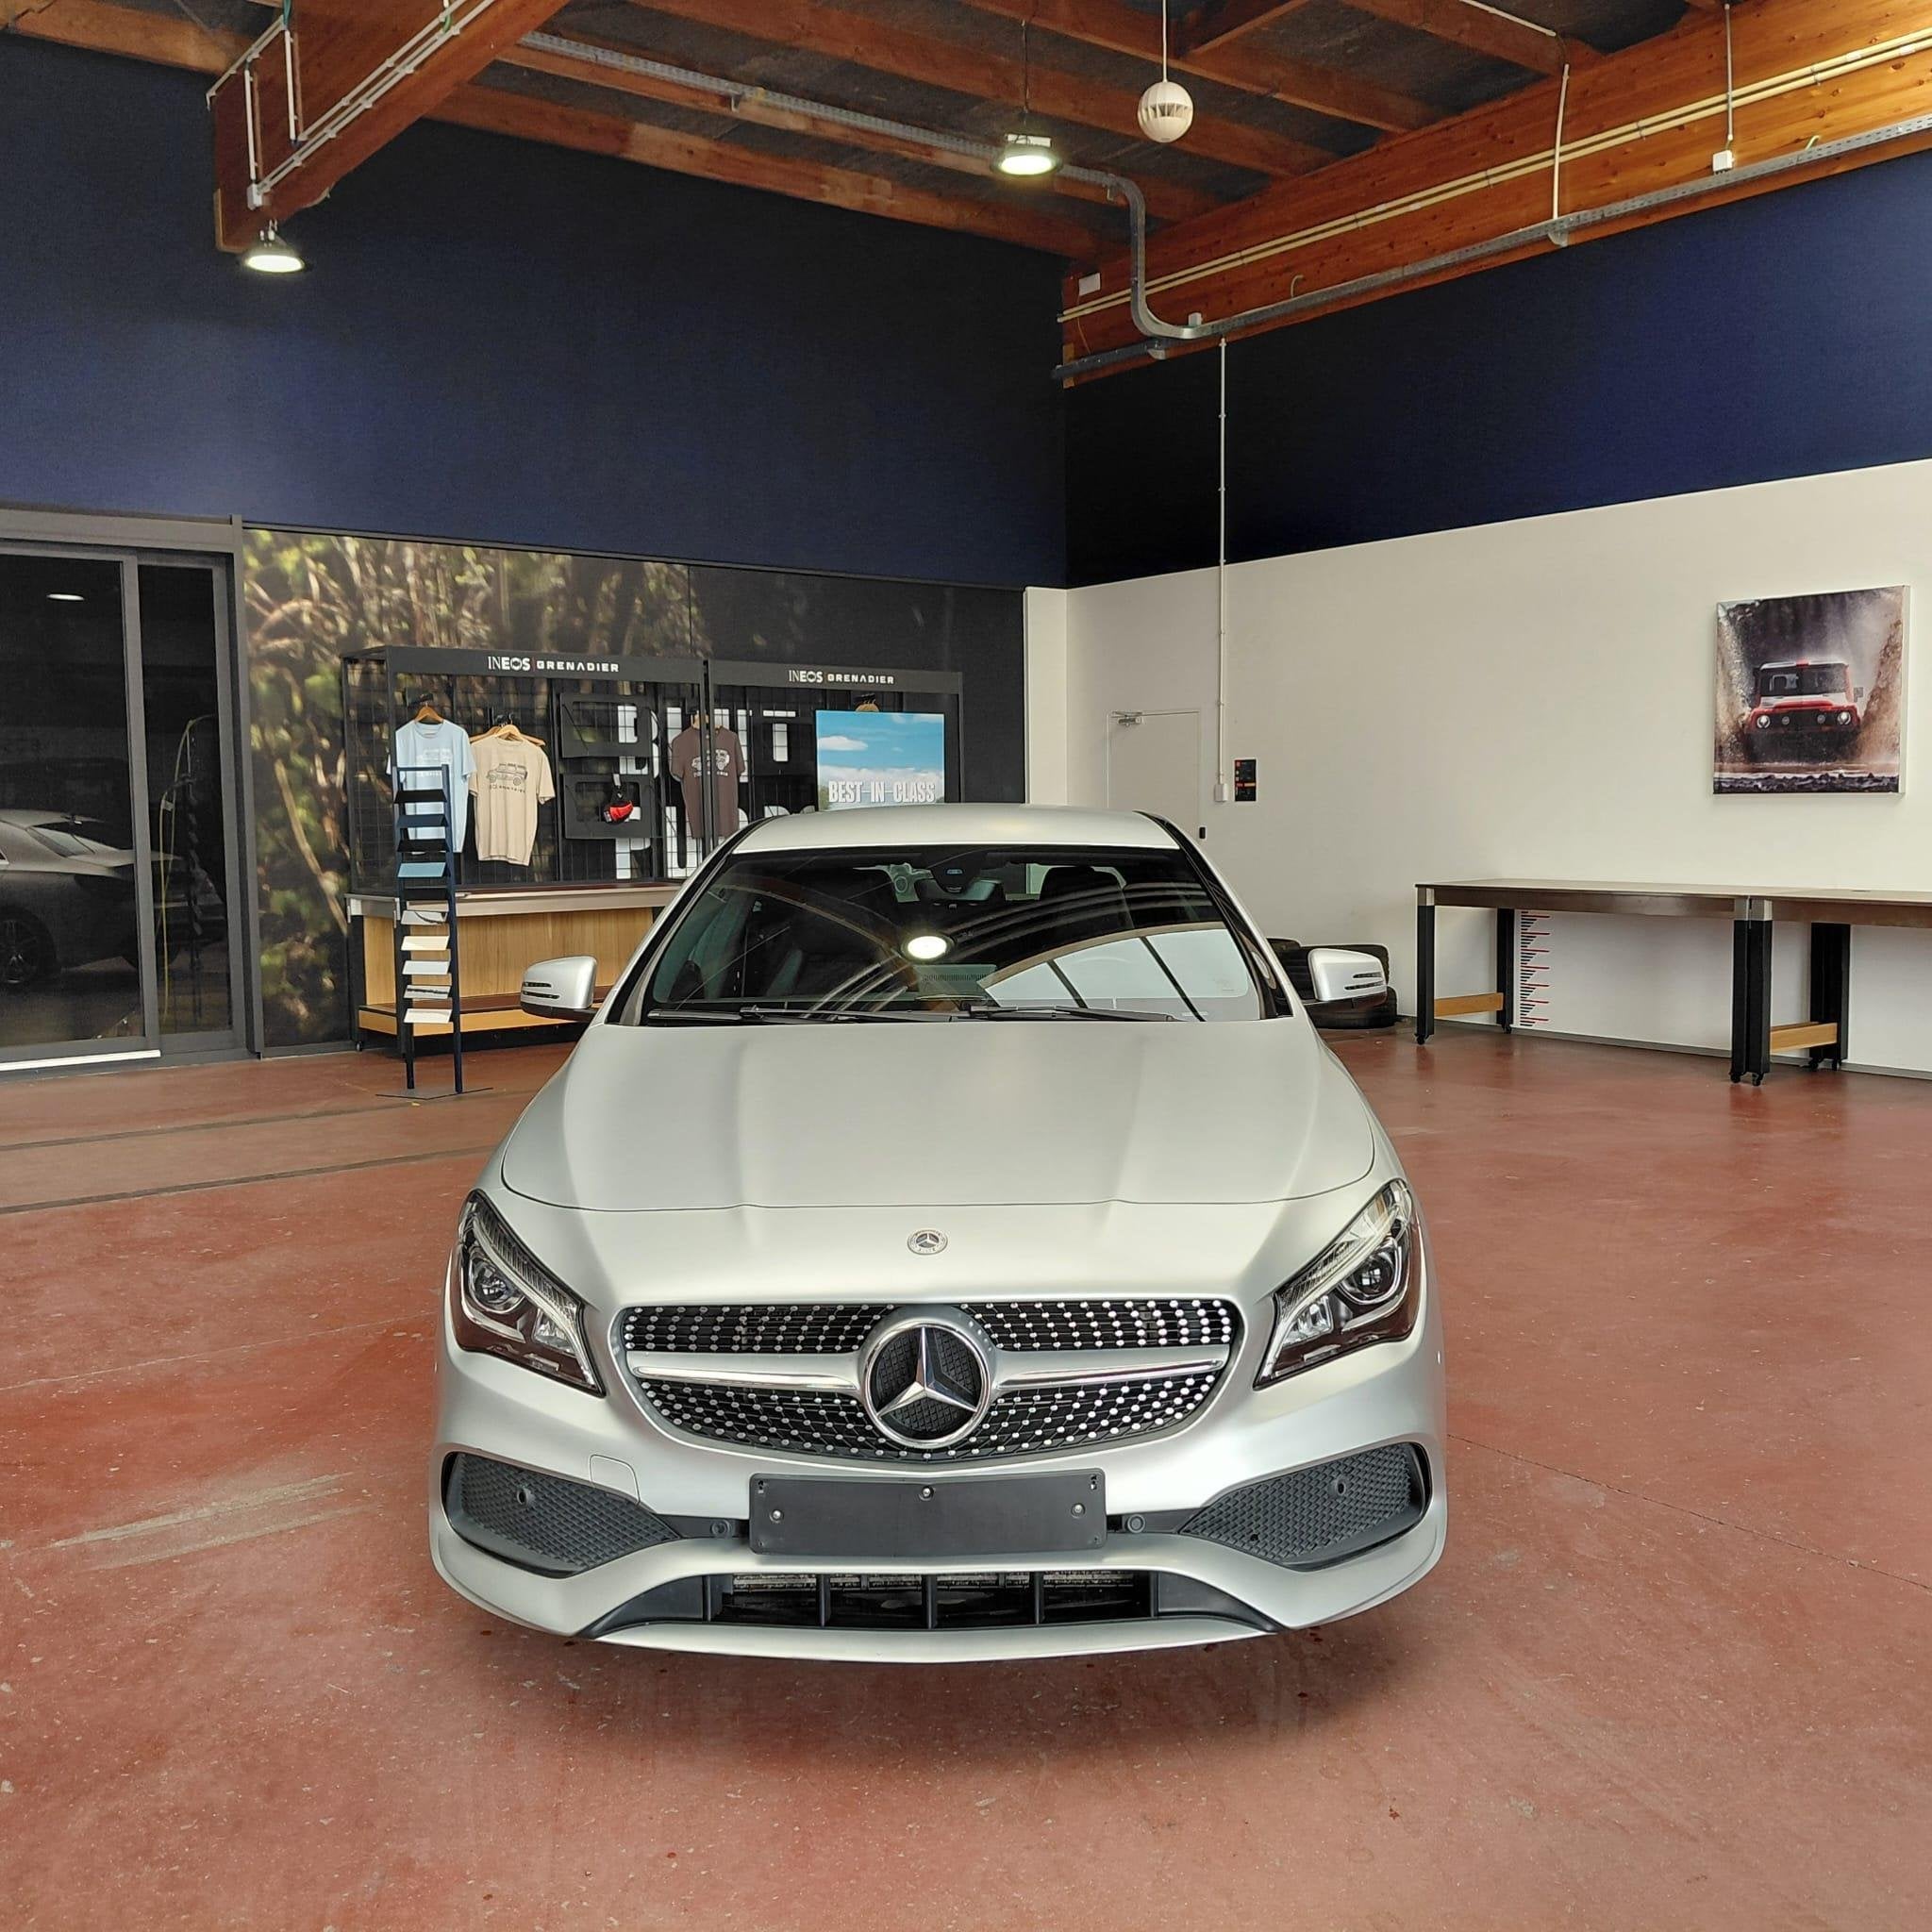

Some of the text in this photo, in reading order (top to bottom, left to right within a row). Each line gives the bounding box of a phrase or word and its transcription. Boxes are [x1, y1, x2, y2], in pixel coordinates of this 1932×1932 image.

[487, 656, 620, 673] INEOS GRENADIER
[788, 670, 894, 685] INEOS GRENADIER
[828, 780, 936, 803] BEST IN CLASS
